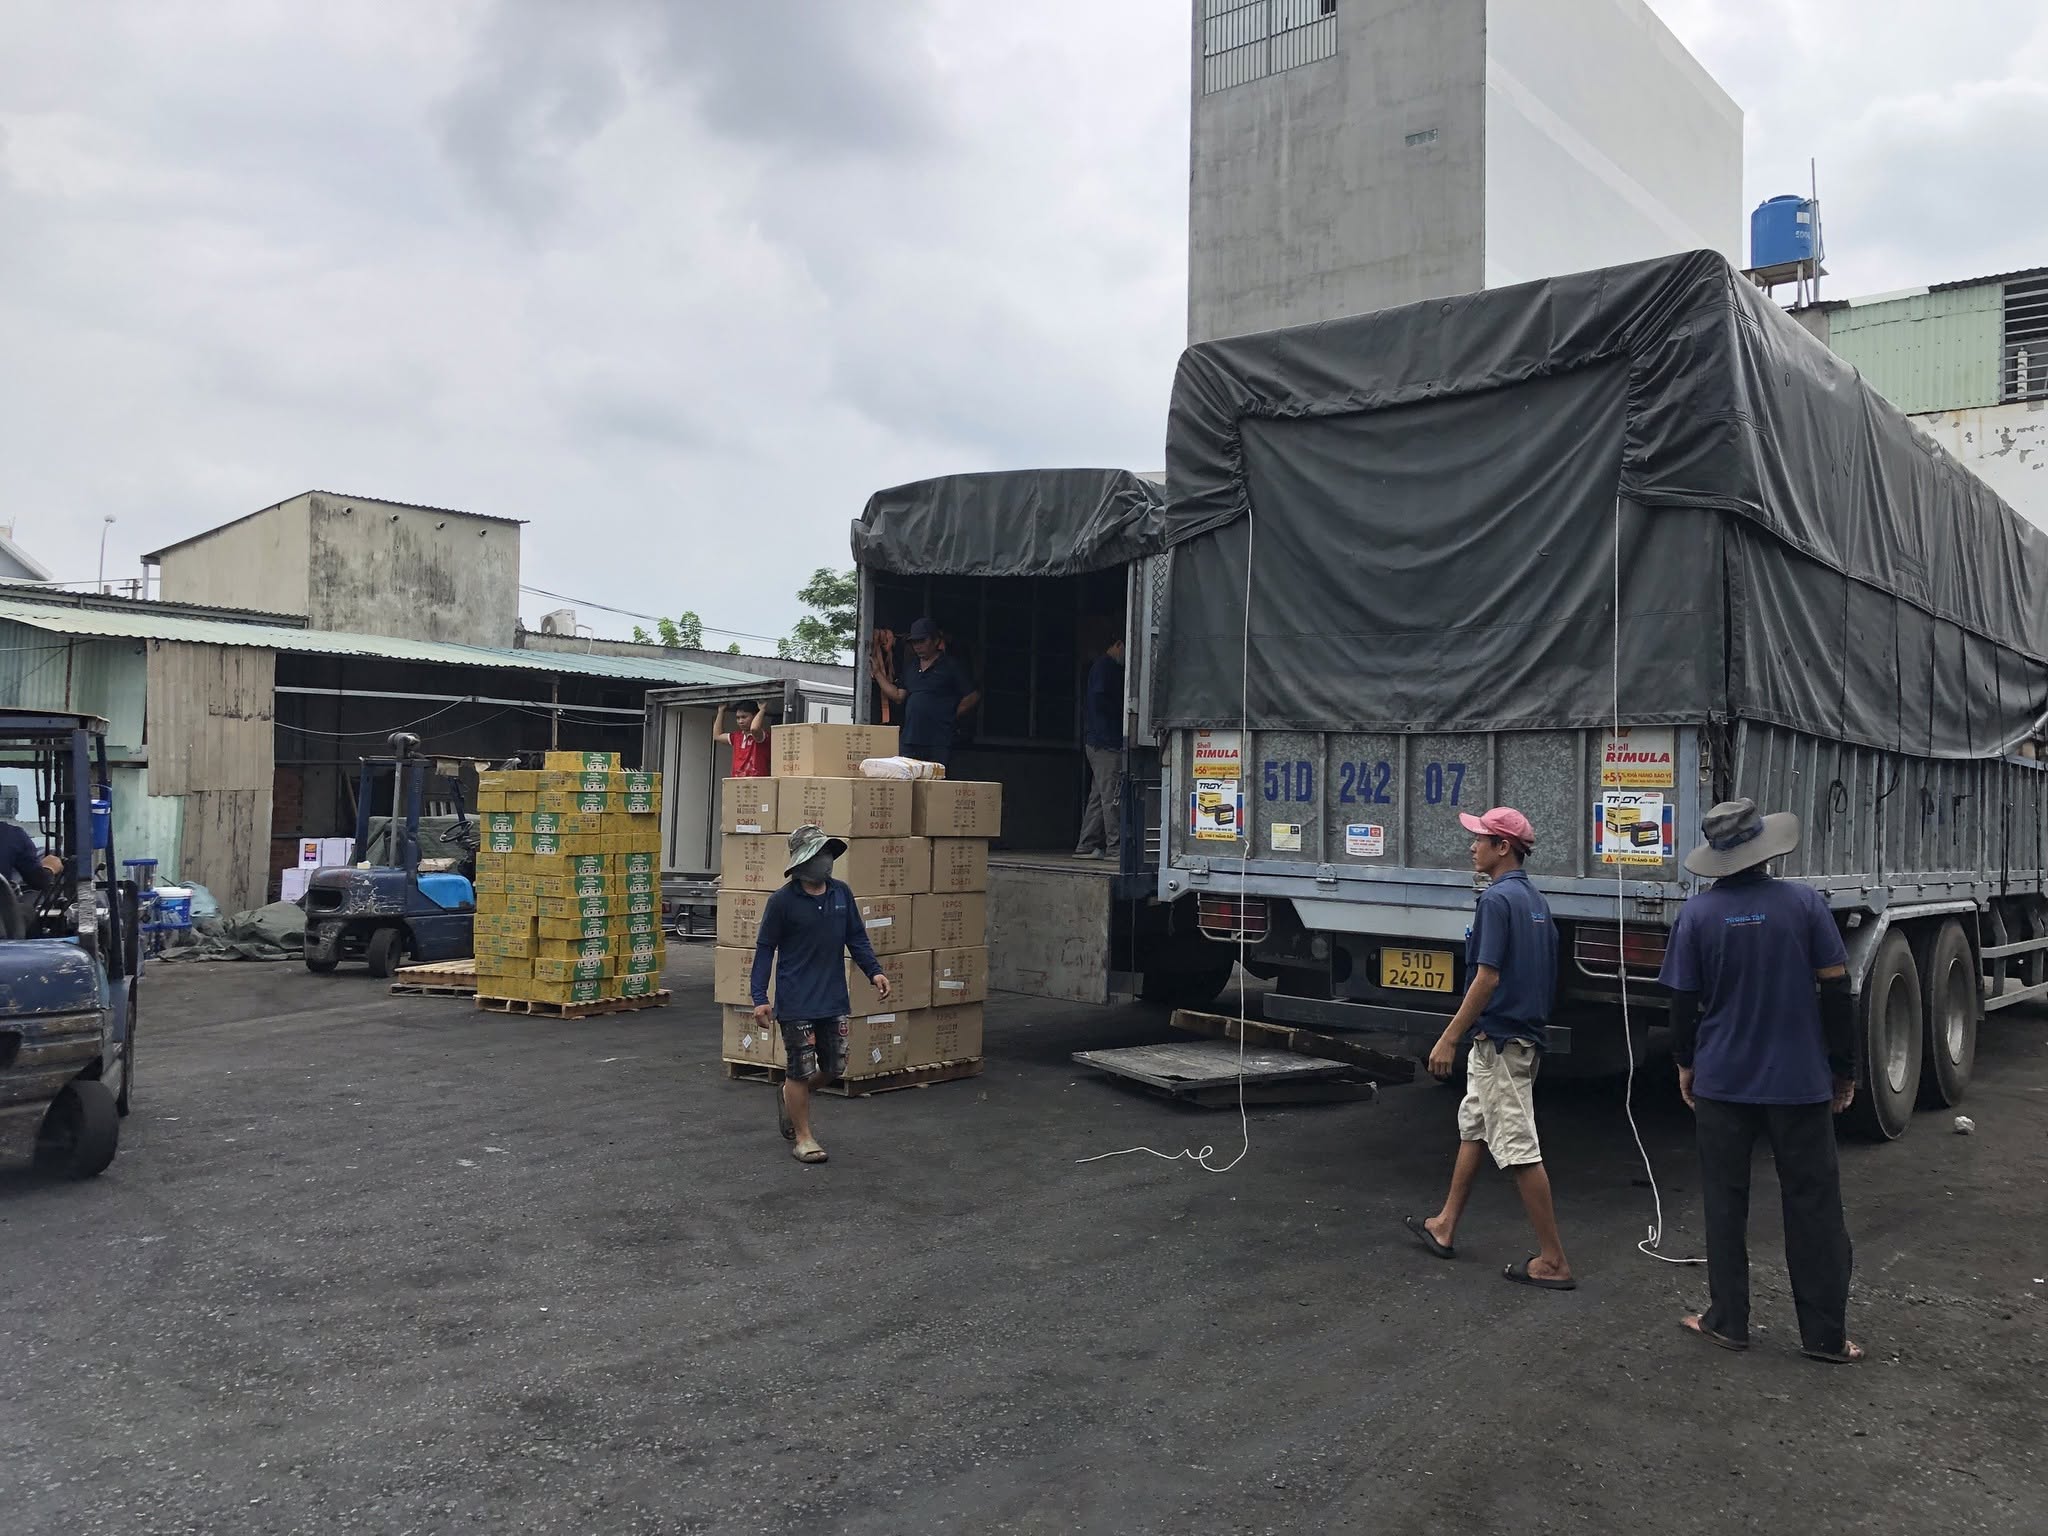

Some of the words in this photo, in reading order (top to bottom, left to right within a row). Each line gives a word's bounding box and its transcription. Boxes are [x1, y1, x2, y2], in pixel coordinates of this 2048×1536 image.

[1607, 743, 1629, 751] Shell
[1195, 749, 1239, 758] RIMULA
[1605, 752, 1670, 763] RIMULA
[1199, 782, 1222, 790] TROY
[1264, 761, 1313, 802] 51D
[1340, 761, 1391, 804] 242
[1425, 762, 1466, 806] 07
[1606, 795, 1642, 804] TROY
[1401, 952, 1433, 970] 51D
[1389, 969, 1445, 989] 242.07
